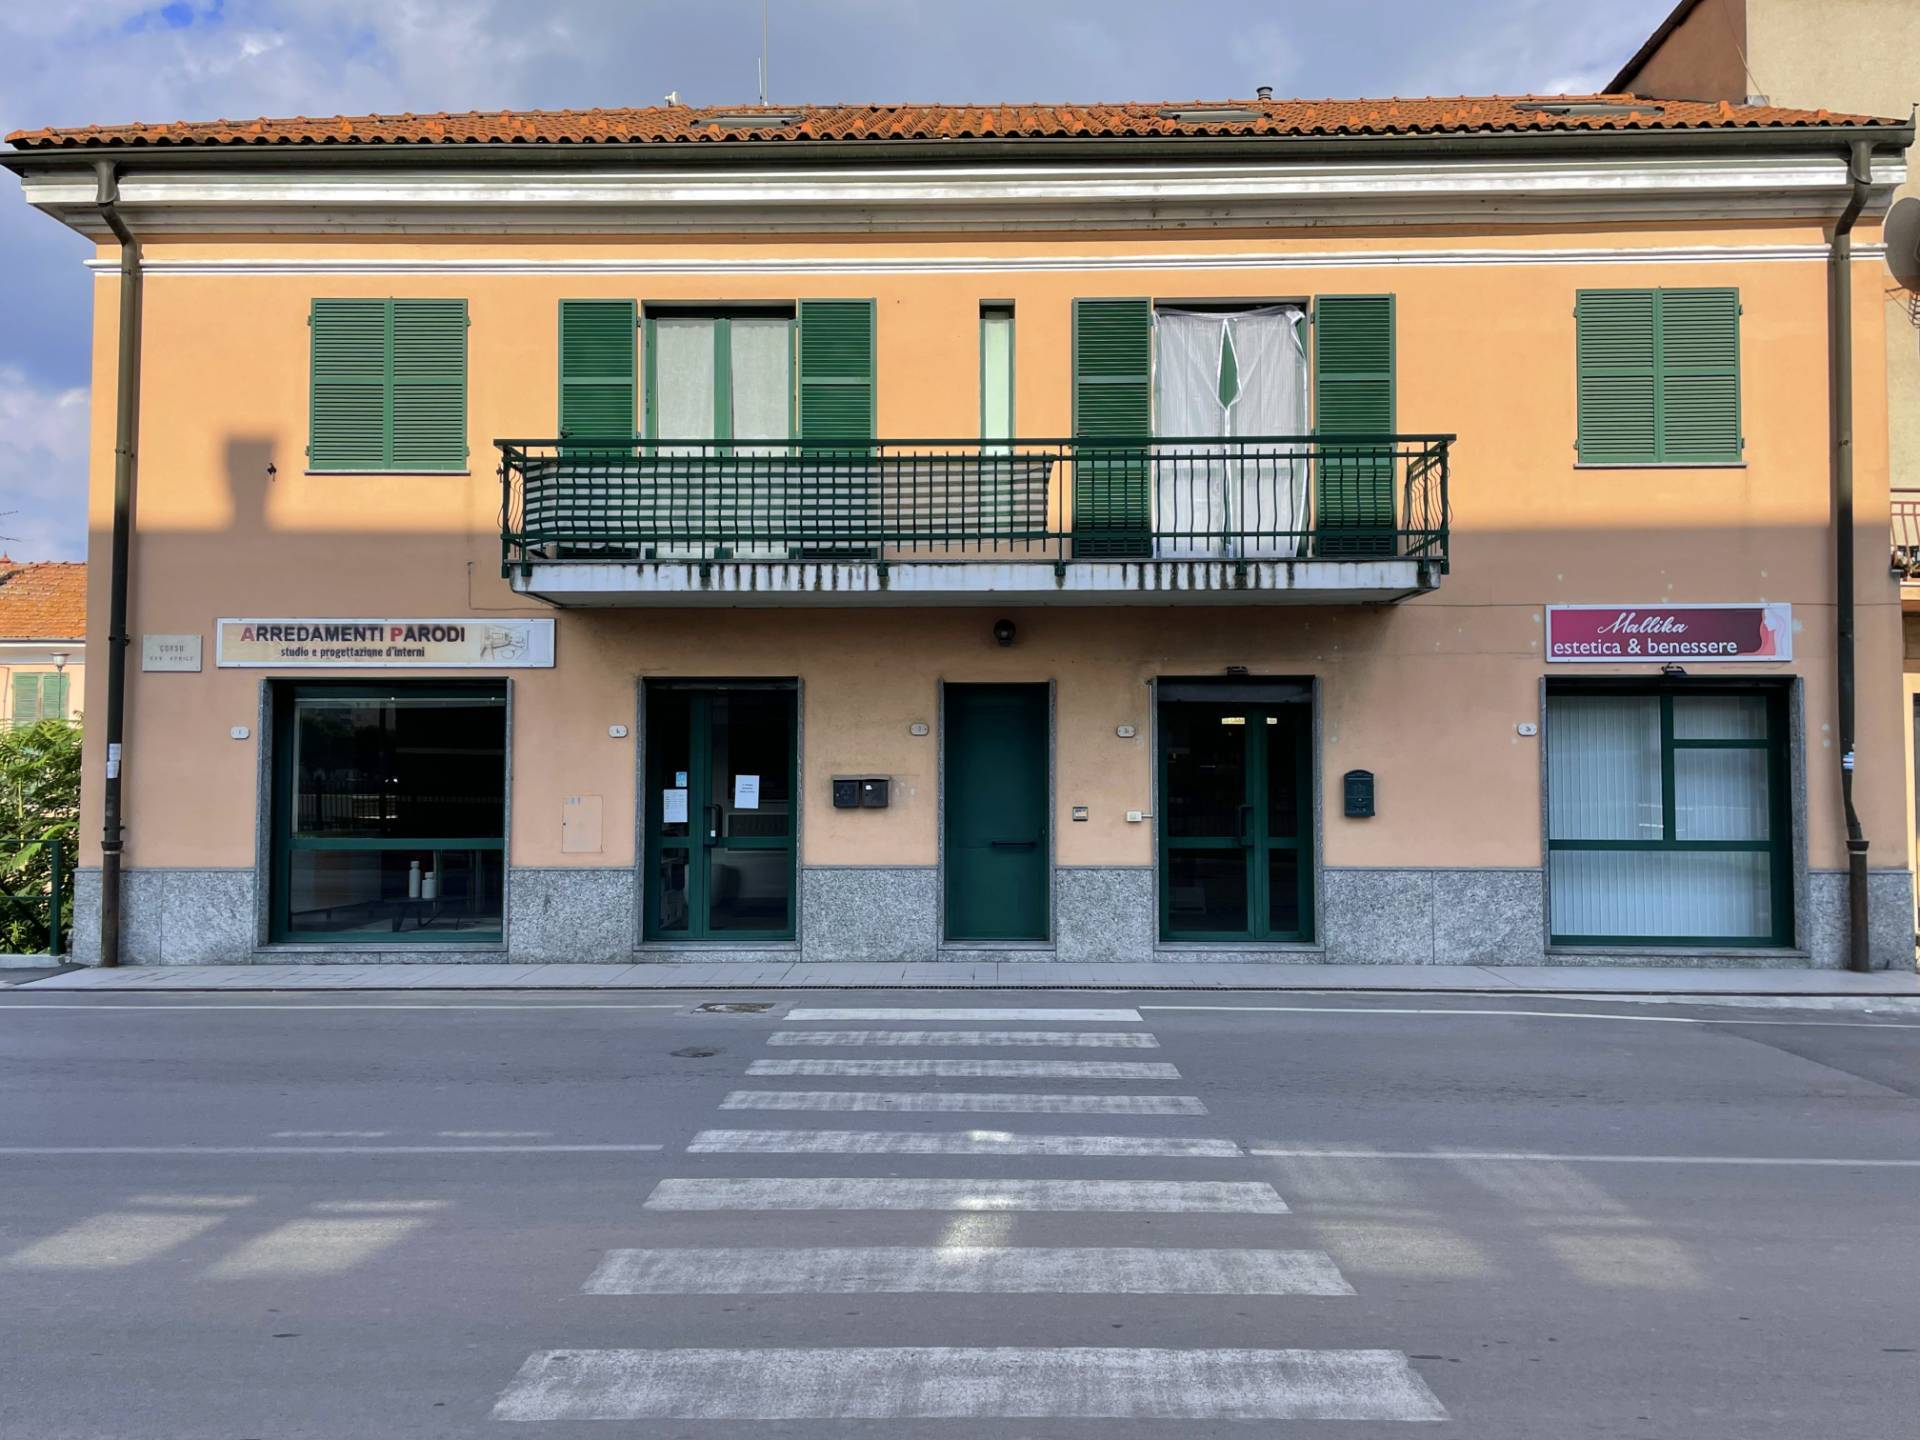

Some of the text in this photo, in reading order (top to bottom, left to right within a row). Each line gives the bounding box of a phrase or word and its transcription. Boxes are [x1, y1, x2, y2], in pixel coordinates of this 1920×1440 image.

[1597, 612, 1688, 634] Mallika
[240, 626, 465, 643] ARREDAMENTI PARODI
[280, 646, 425, 659] studio e progettazione d'interni
[1553, 638, 1738, 654] estetica & benessere
